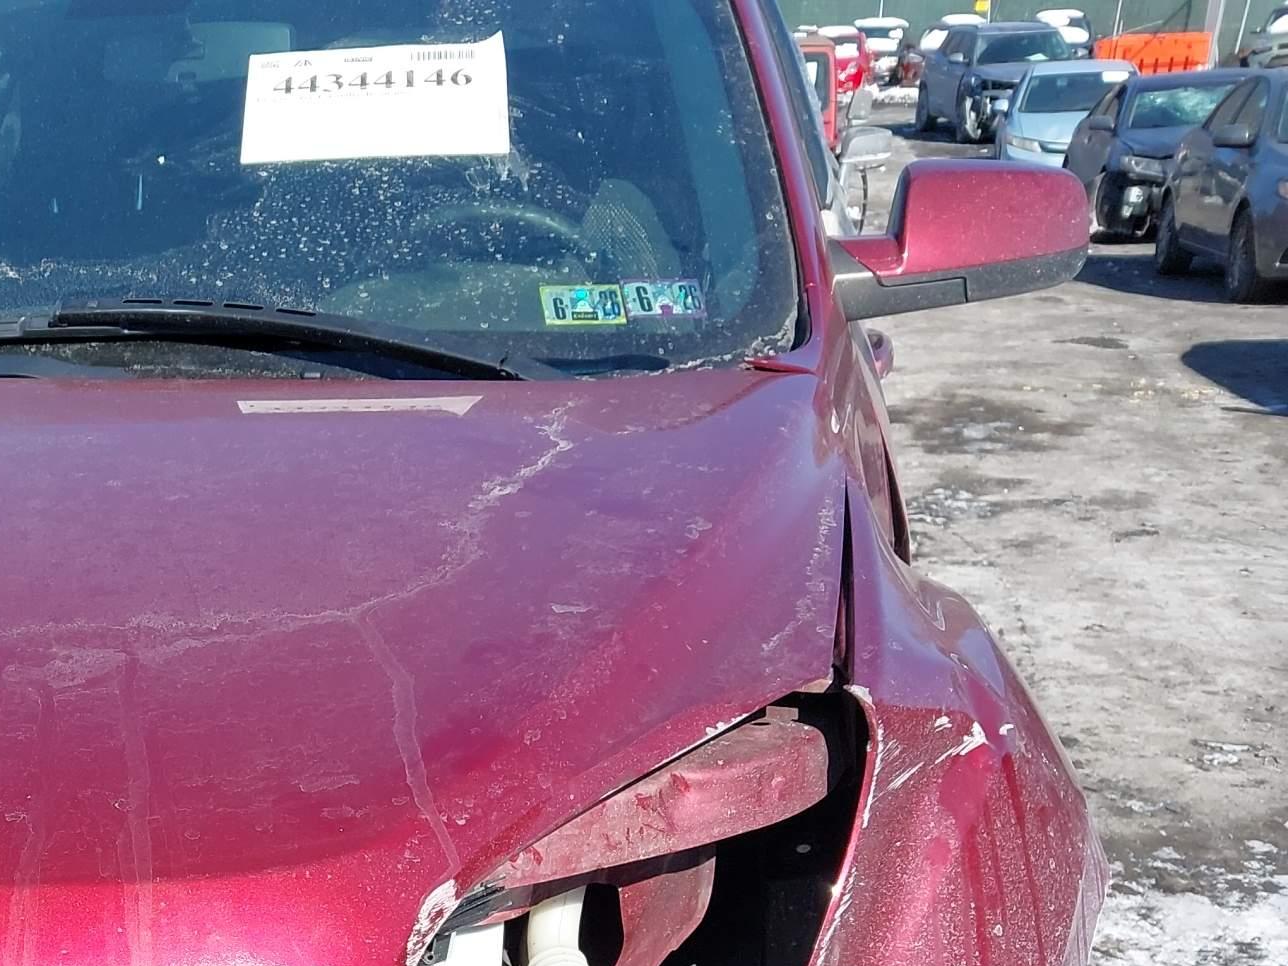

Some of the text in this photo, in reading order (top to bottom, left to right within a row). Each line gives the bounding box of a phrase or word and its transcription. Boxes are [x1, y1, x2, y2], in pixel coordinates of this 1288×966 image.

[272, 68, 473, 95] 44344146
[552, 297, 567, 320] 6
[635, 286, 653, 312] 6
